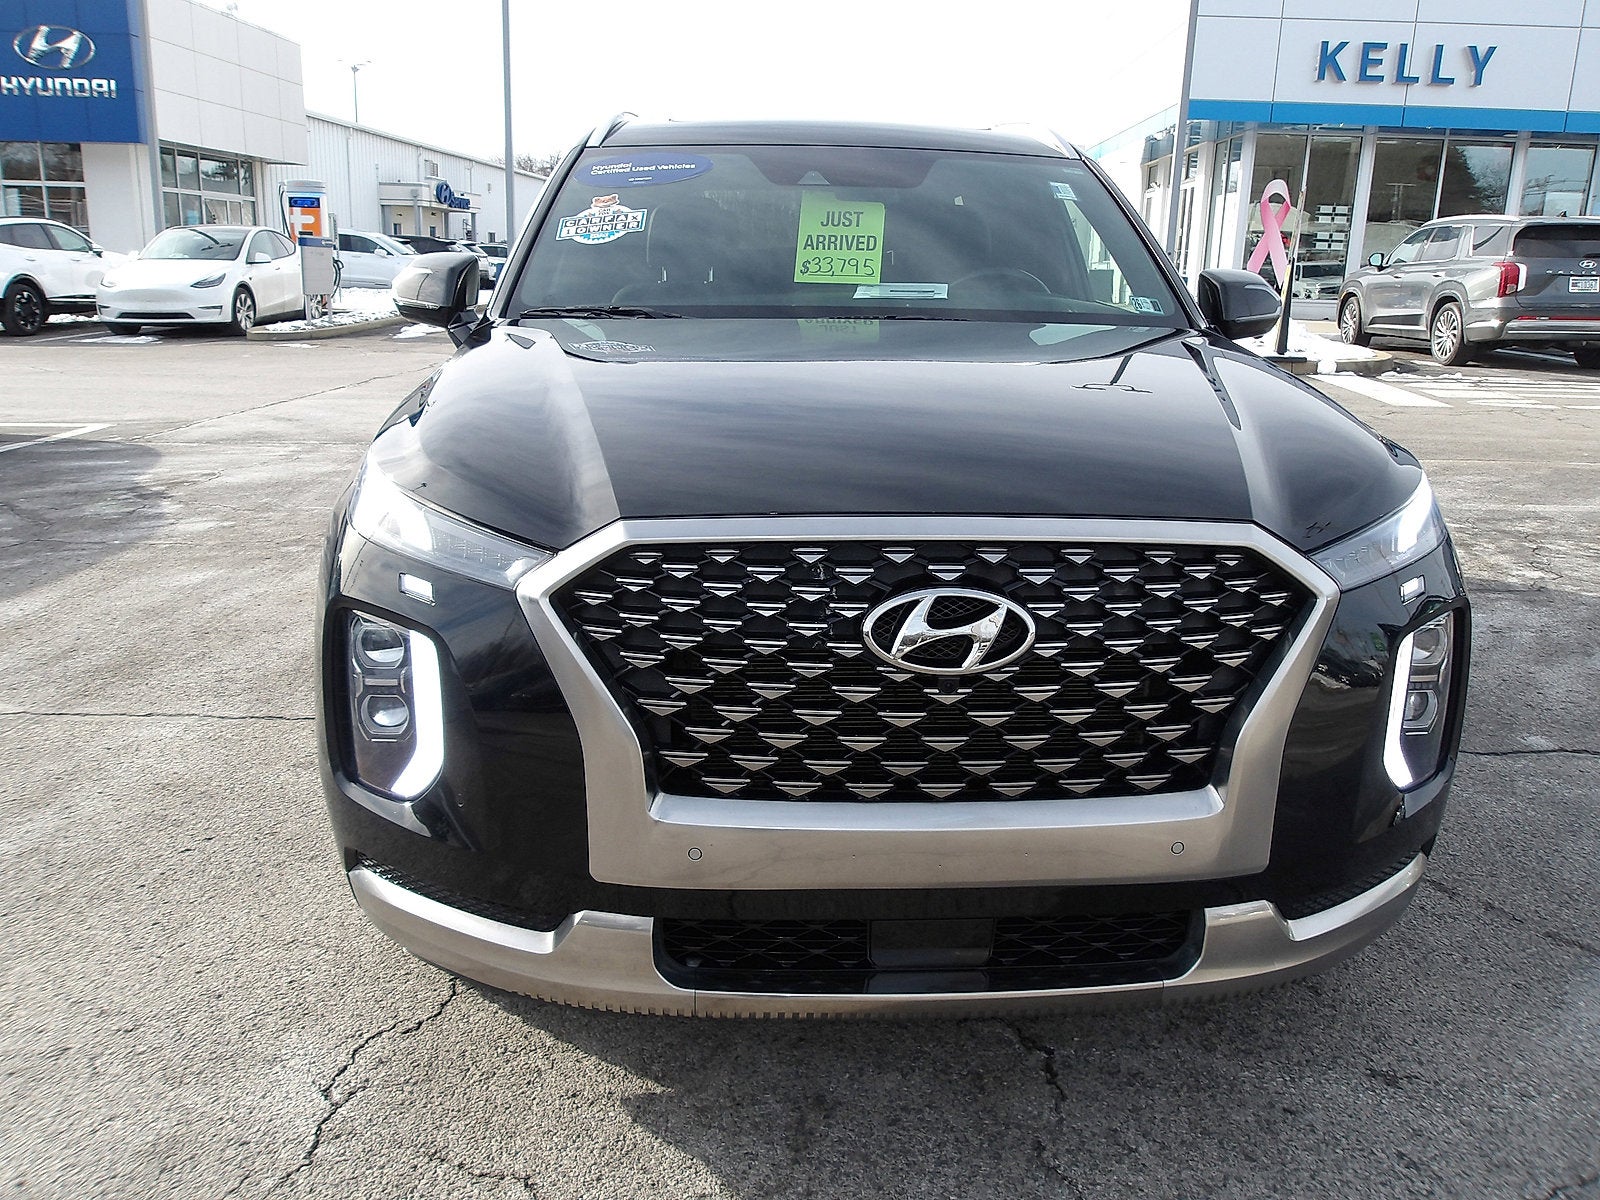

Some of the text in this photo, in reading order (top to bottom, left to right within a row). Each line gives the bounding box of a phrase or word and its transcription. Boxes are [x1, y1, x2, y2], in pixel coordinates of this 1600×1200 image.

[1316, 40, 1498, 87] KELLY
[0, 76, 118, 99] HYUNDAI
[590, 163, 696, 175] Certified Used Vehicles
[592, 162, 633, 171] Hyundai
[564, 214, 639, 228] CARFAX
[575, 221, 641, 235] OWNER
[820, 211, 864, 228] JUST
[803, 234, 878, 251] ARRIVED
[800, 256, 876, 277] $33,795
